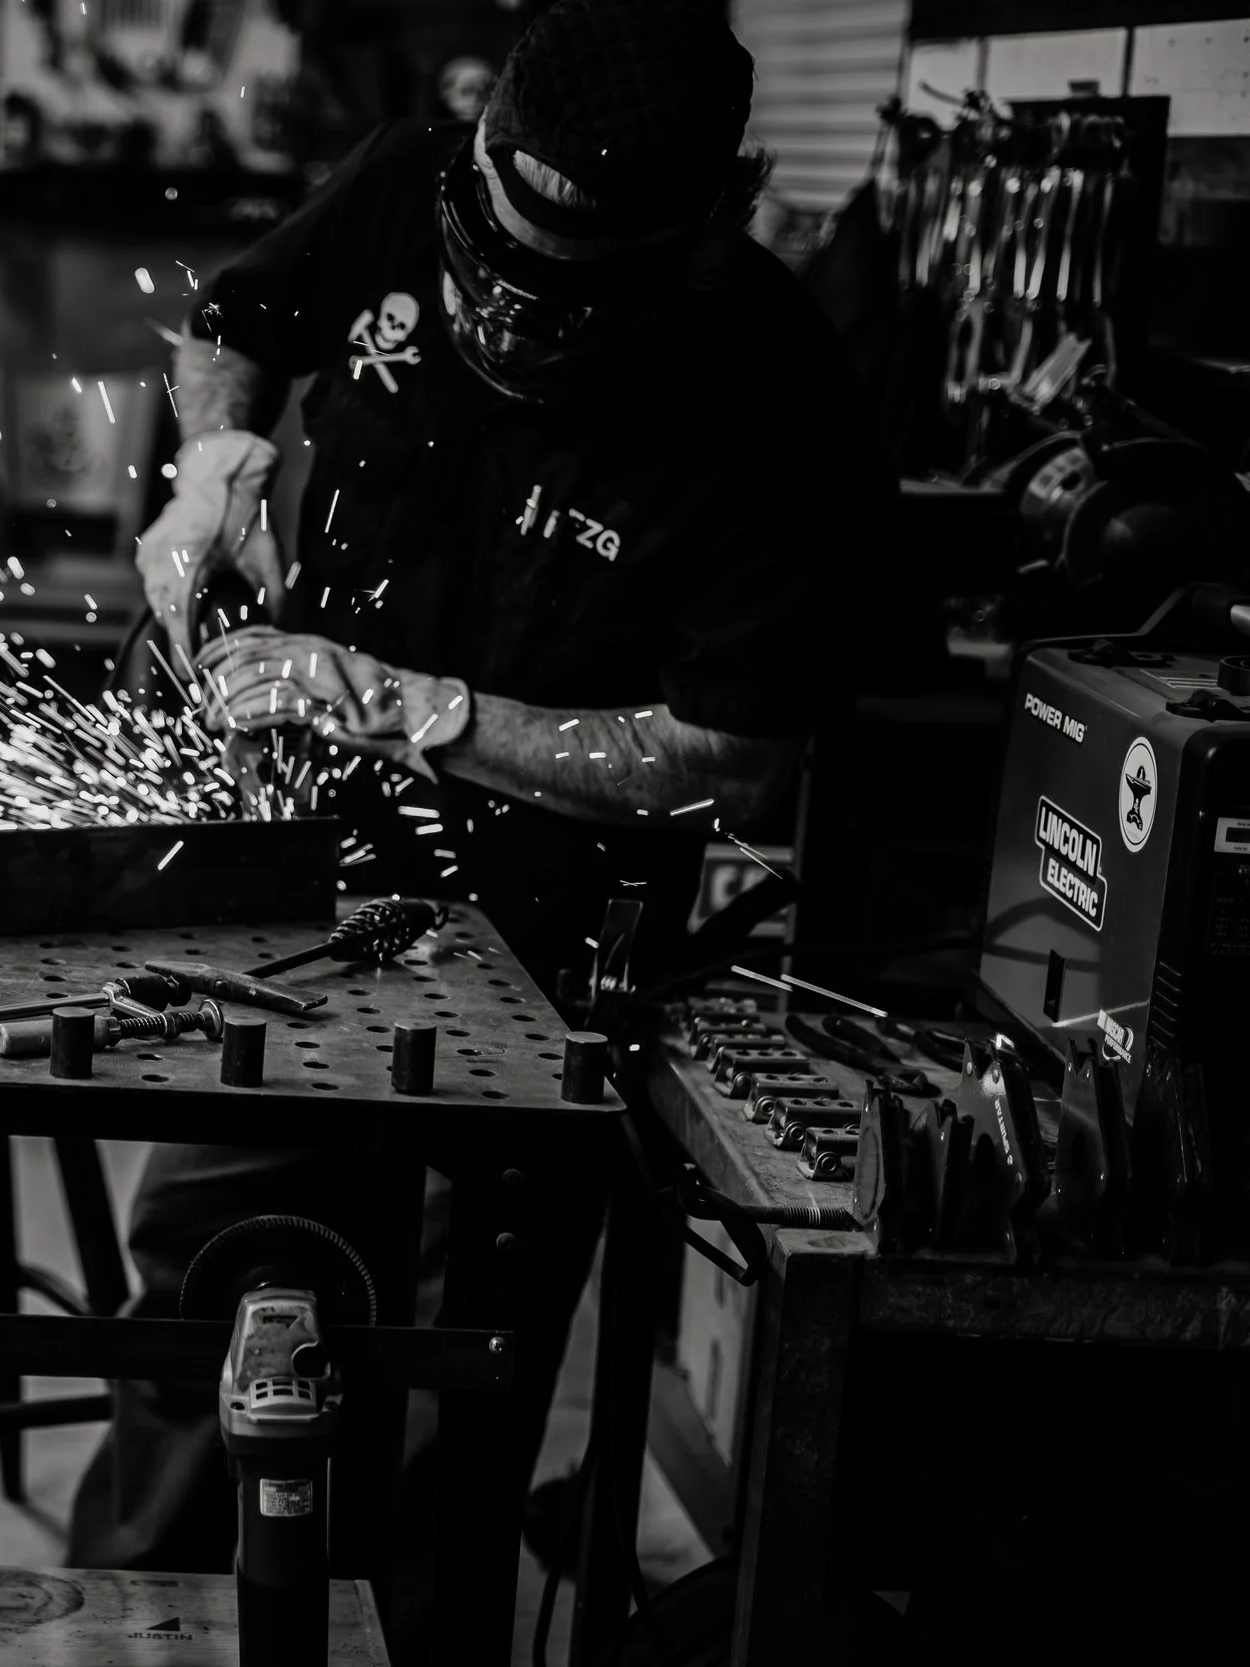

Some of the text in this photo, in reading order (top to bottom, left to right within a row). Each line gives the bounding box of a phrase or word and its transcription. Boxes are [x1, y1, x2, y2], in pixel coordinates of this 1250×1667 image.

[1024, 691, 1086, 744] POWER MIG
[1038, 805, 1098, 878] LINCOLN
[1046, 857, 1099, 918] ELECTRIC
[128, 1632, 193, 1641] JUSTIN
